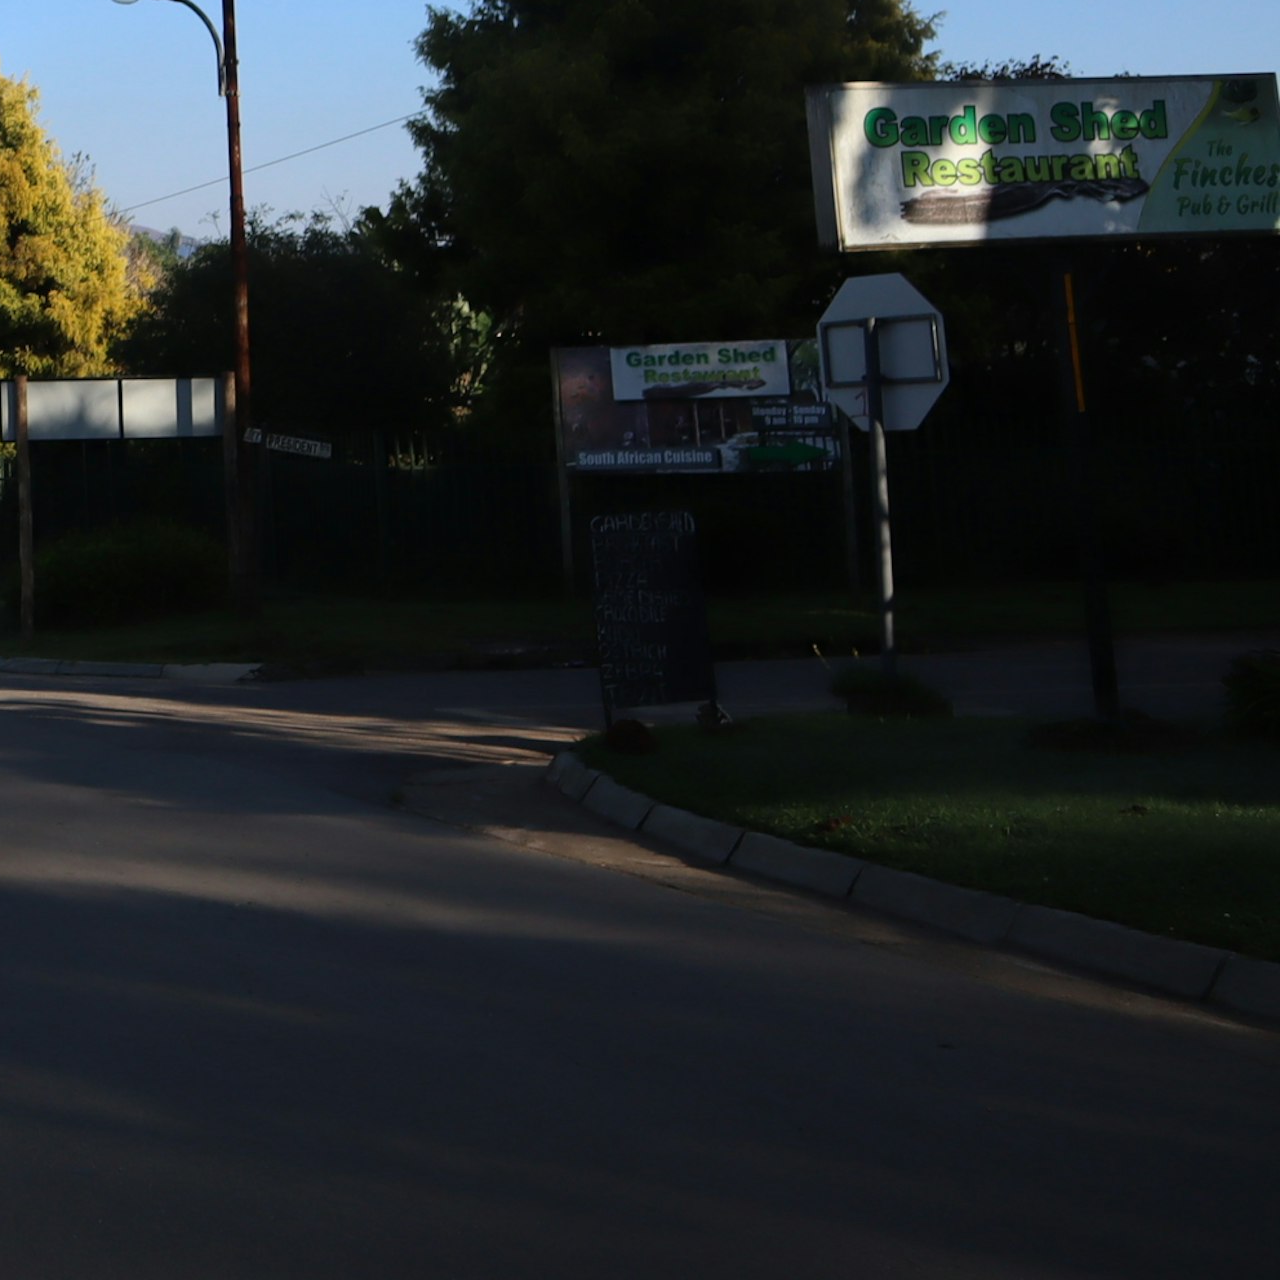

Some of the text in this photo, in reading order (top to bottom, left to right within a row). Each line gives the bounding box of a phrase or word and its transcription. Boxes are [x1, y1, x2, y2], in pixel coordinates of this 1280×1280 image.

[863, 99, 1168, 148] Garden Shed
[1207, 138, 1233, 157] The
[900, 144, 1141, 187] Restaurant
[1173, 153, 1280, 190] Finches
[1177, 191, 1279, 216] Pub & Grill
[625, 346, 777, 368] Garden Shed
[643, 366, 761, 384] Restaurant
[793, 405, 825, 415] Sunday
[268, 433, 318, 455] PRESIDENT
[578, 449, 713, 466] South African Cuisine
